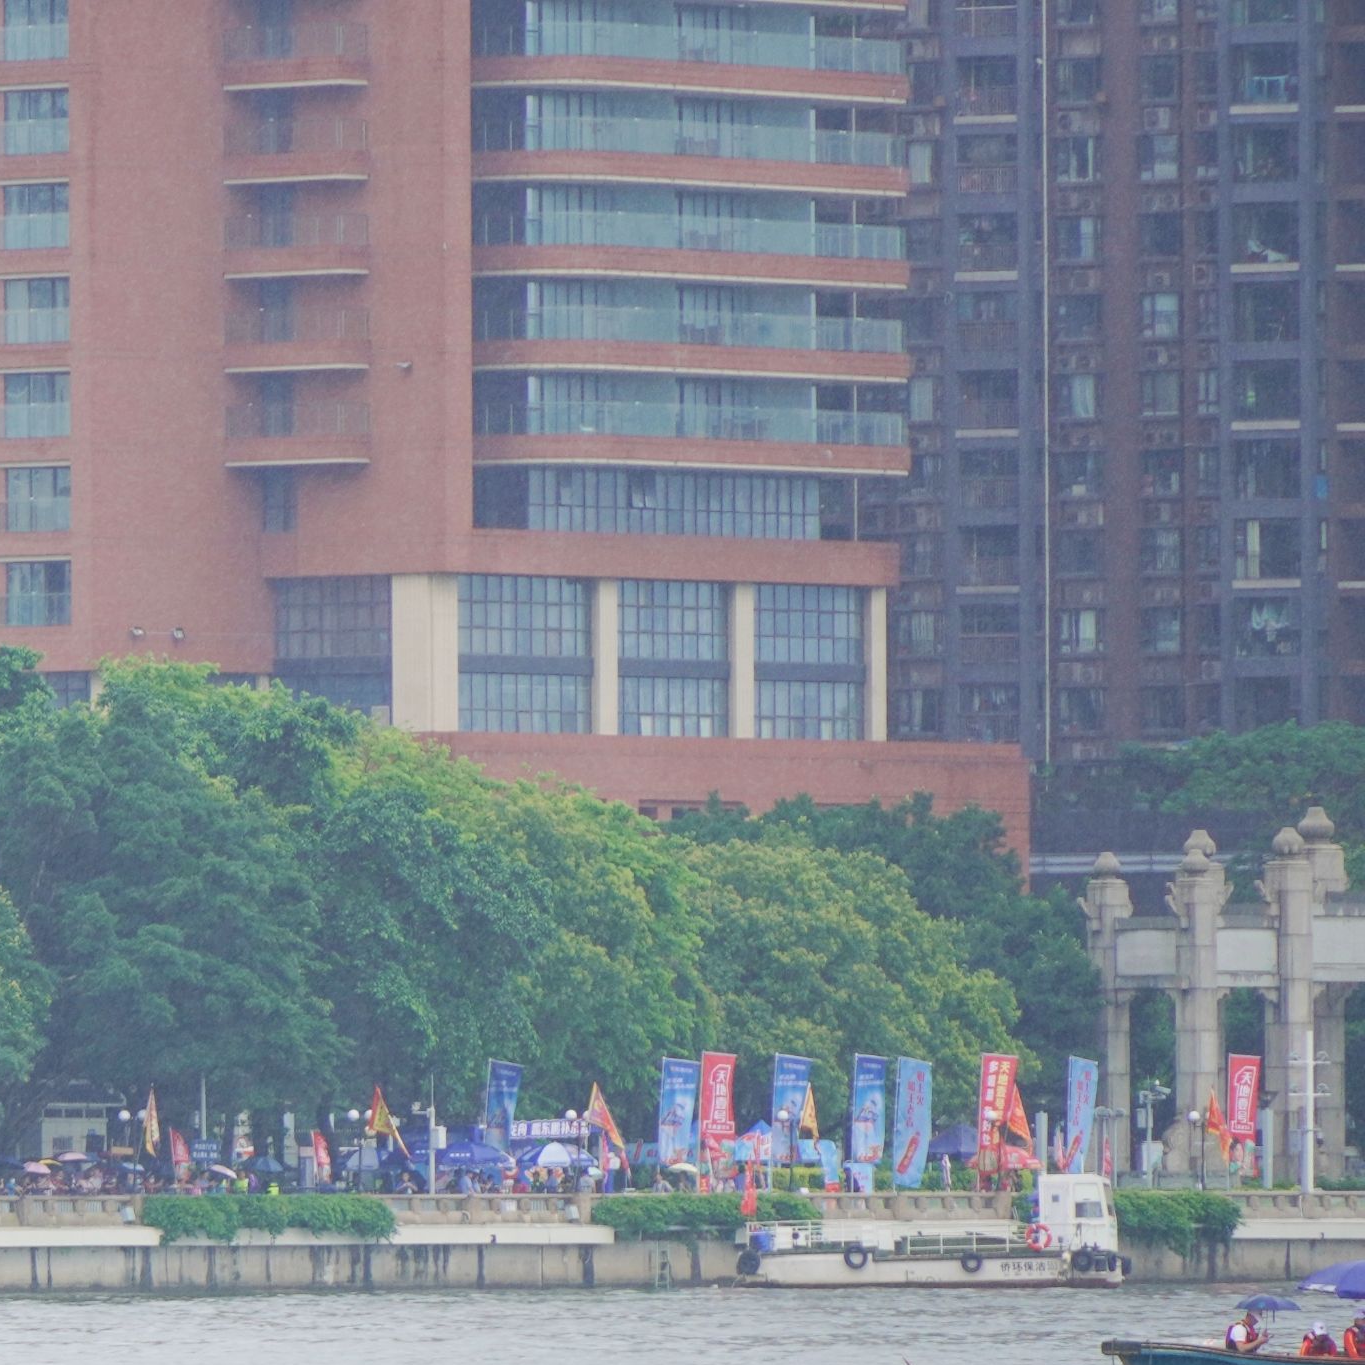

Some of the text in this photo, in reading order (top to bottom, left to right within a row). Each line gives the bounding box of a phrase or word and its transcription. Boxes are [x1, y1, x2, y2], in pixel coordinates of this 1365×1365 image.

[714, 1070, 728, 1123] 天地壹号
[1237, 1072, 1252, 1123] 天地壹号
